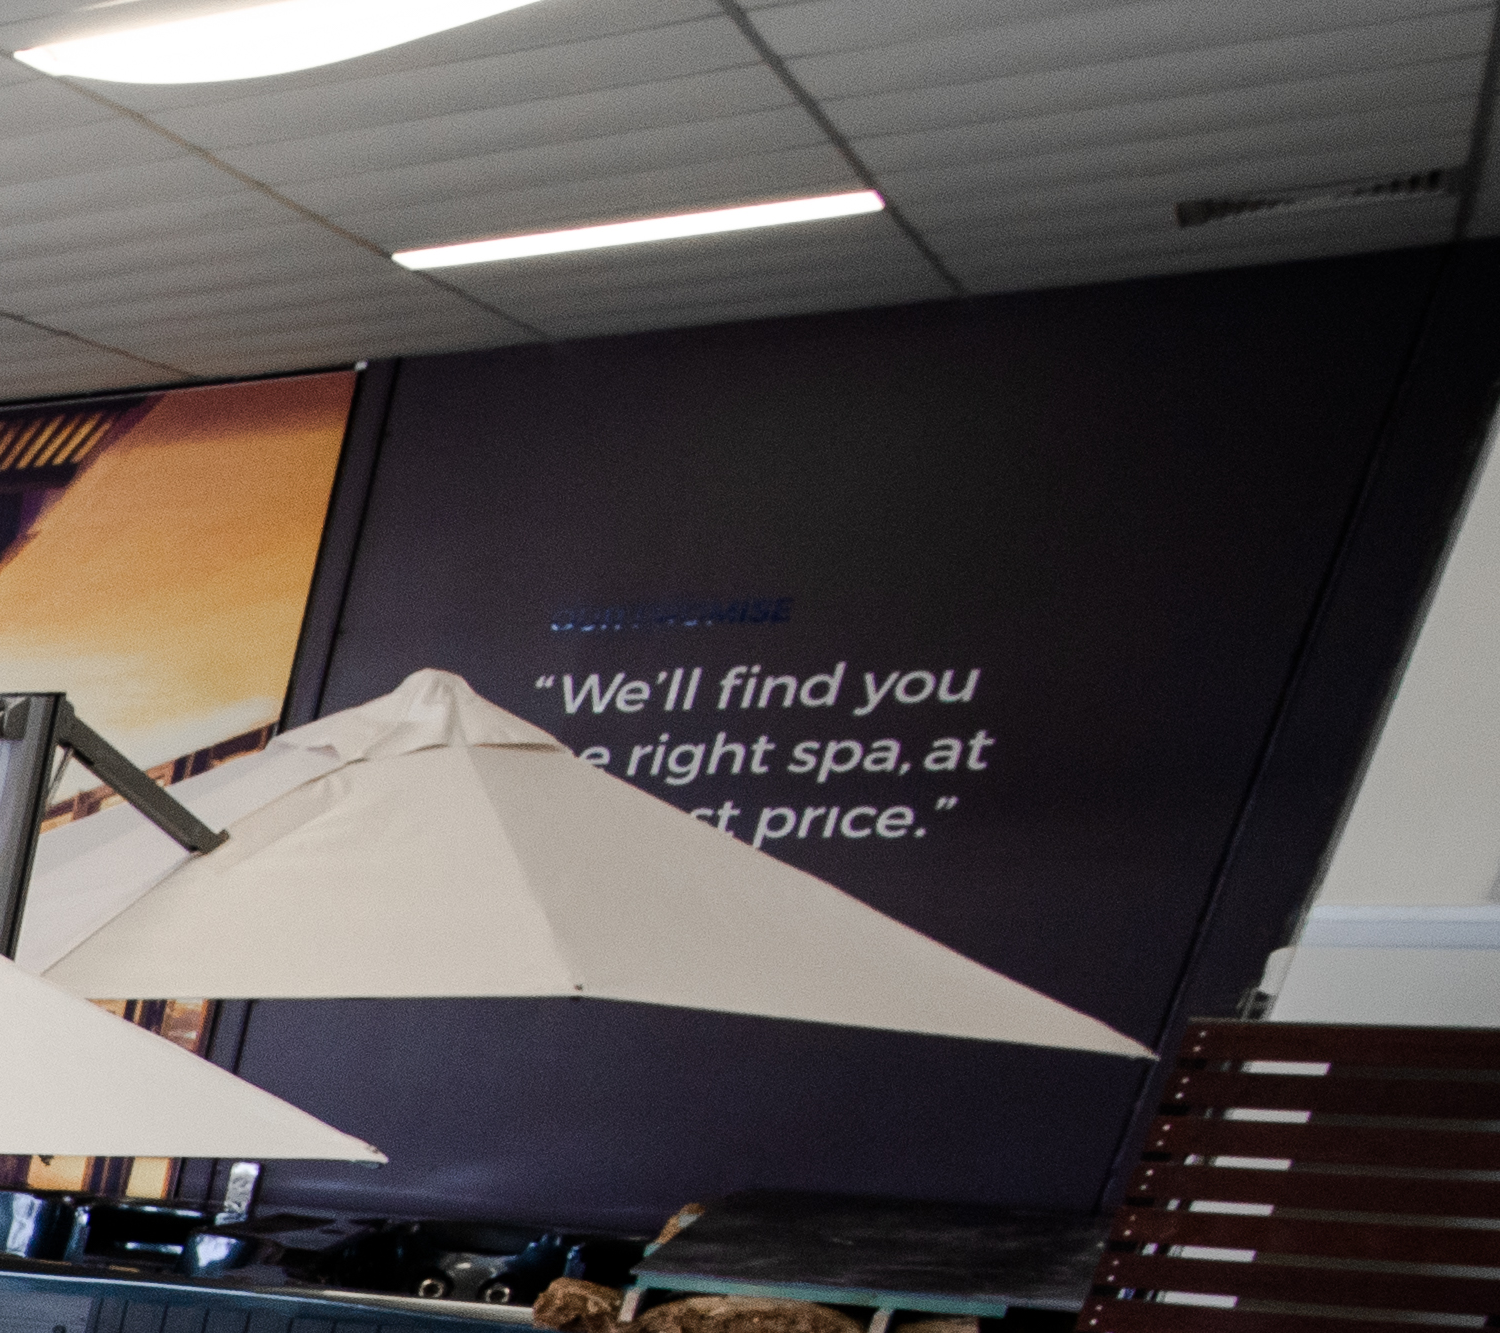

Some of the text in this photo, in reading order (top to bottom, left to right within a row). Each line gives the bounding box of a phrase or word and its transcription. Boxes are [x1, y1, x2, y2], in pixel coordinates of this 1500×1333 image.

[717, 660, 846, 711] find
[853, 667, 981, 717] you
[626, 731, 777, 786] right
[787, 736, 912, 784] spa,
[923, 729, 996, 771] at
